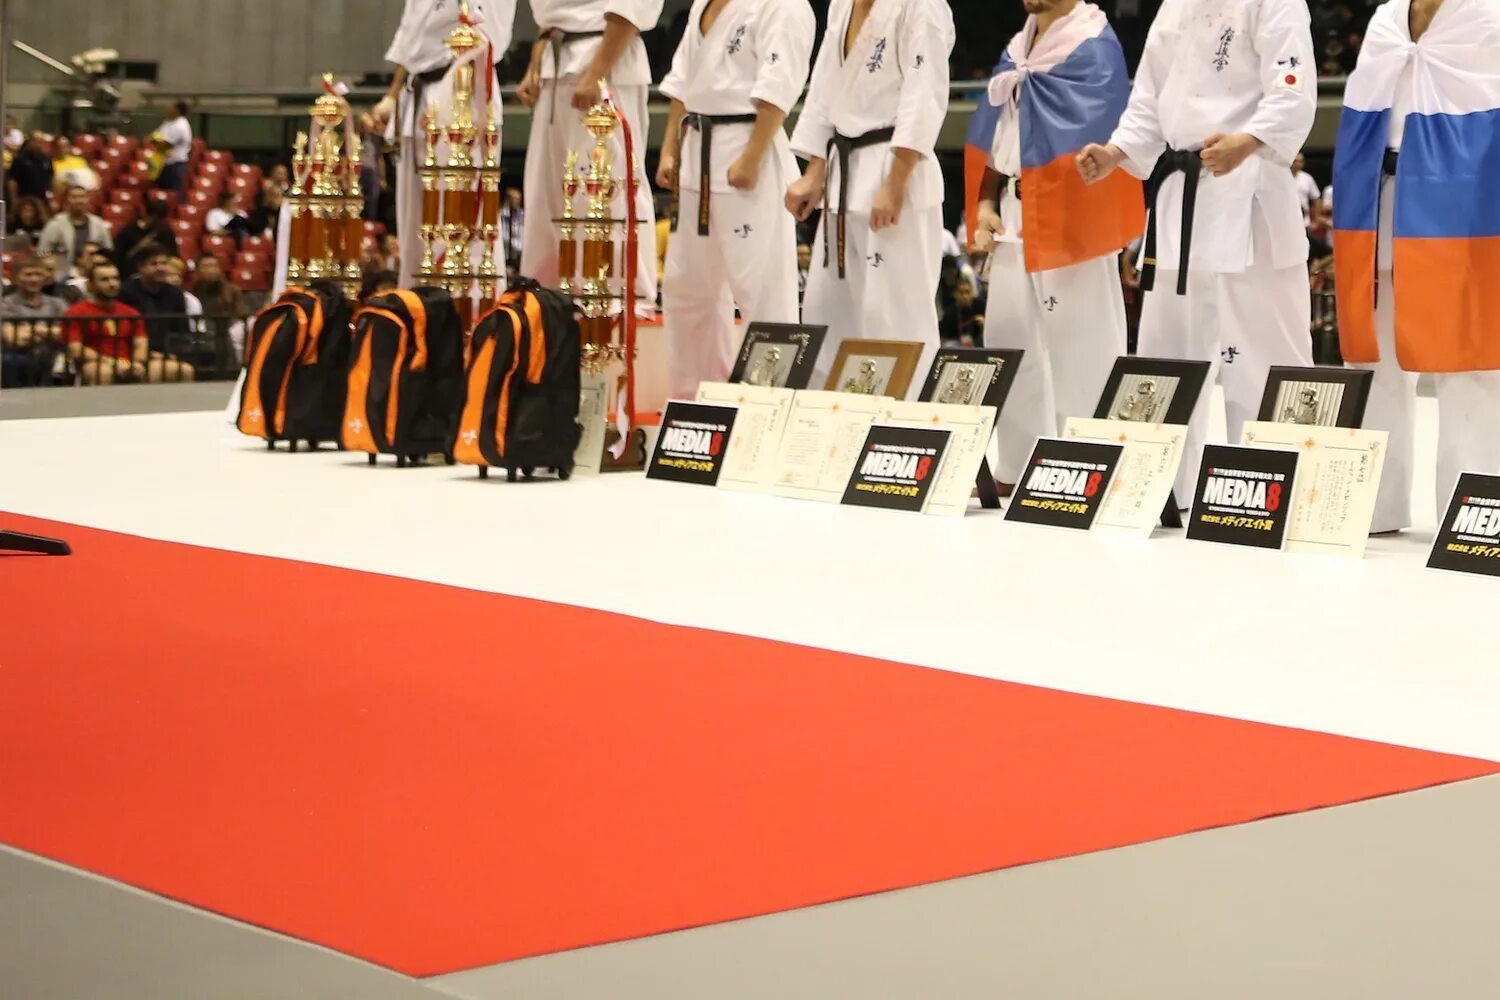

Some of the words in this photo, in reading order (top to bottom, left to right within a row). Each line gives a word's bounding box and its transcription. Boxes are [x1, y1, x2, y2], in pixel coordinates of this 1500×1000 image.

[661, 427, 724, 456] MEDIA8
[860, 451, 932, 480] MEDIA8
[1026, 466, 1102, 497] MEDIA8
[1202, 476, 1282, 512] MEDIA8
